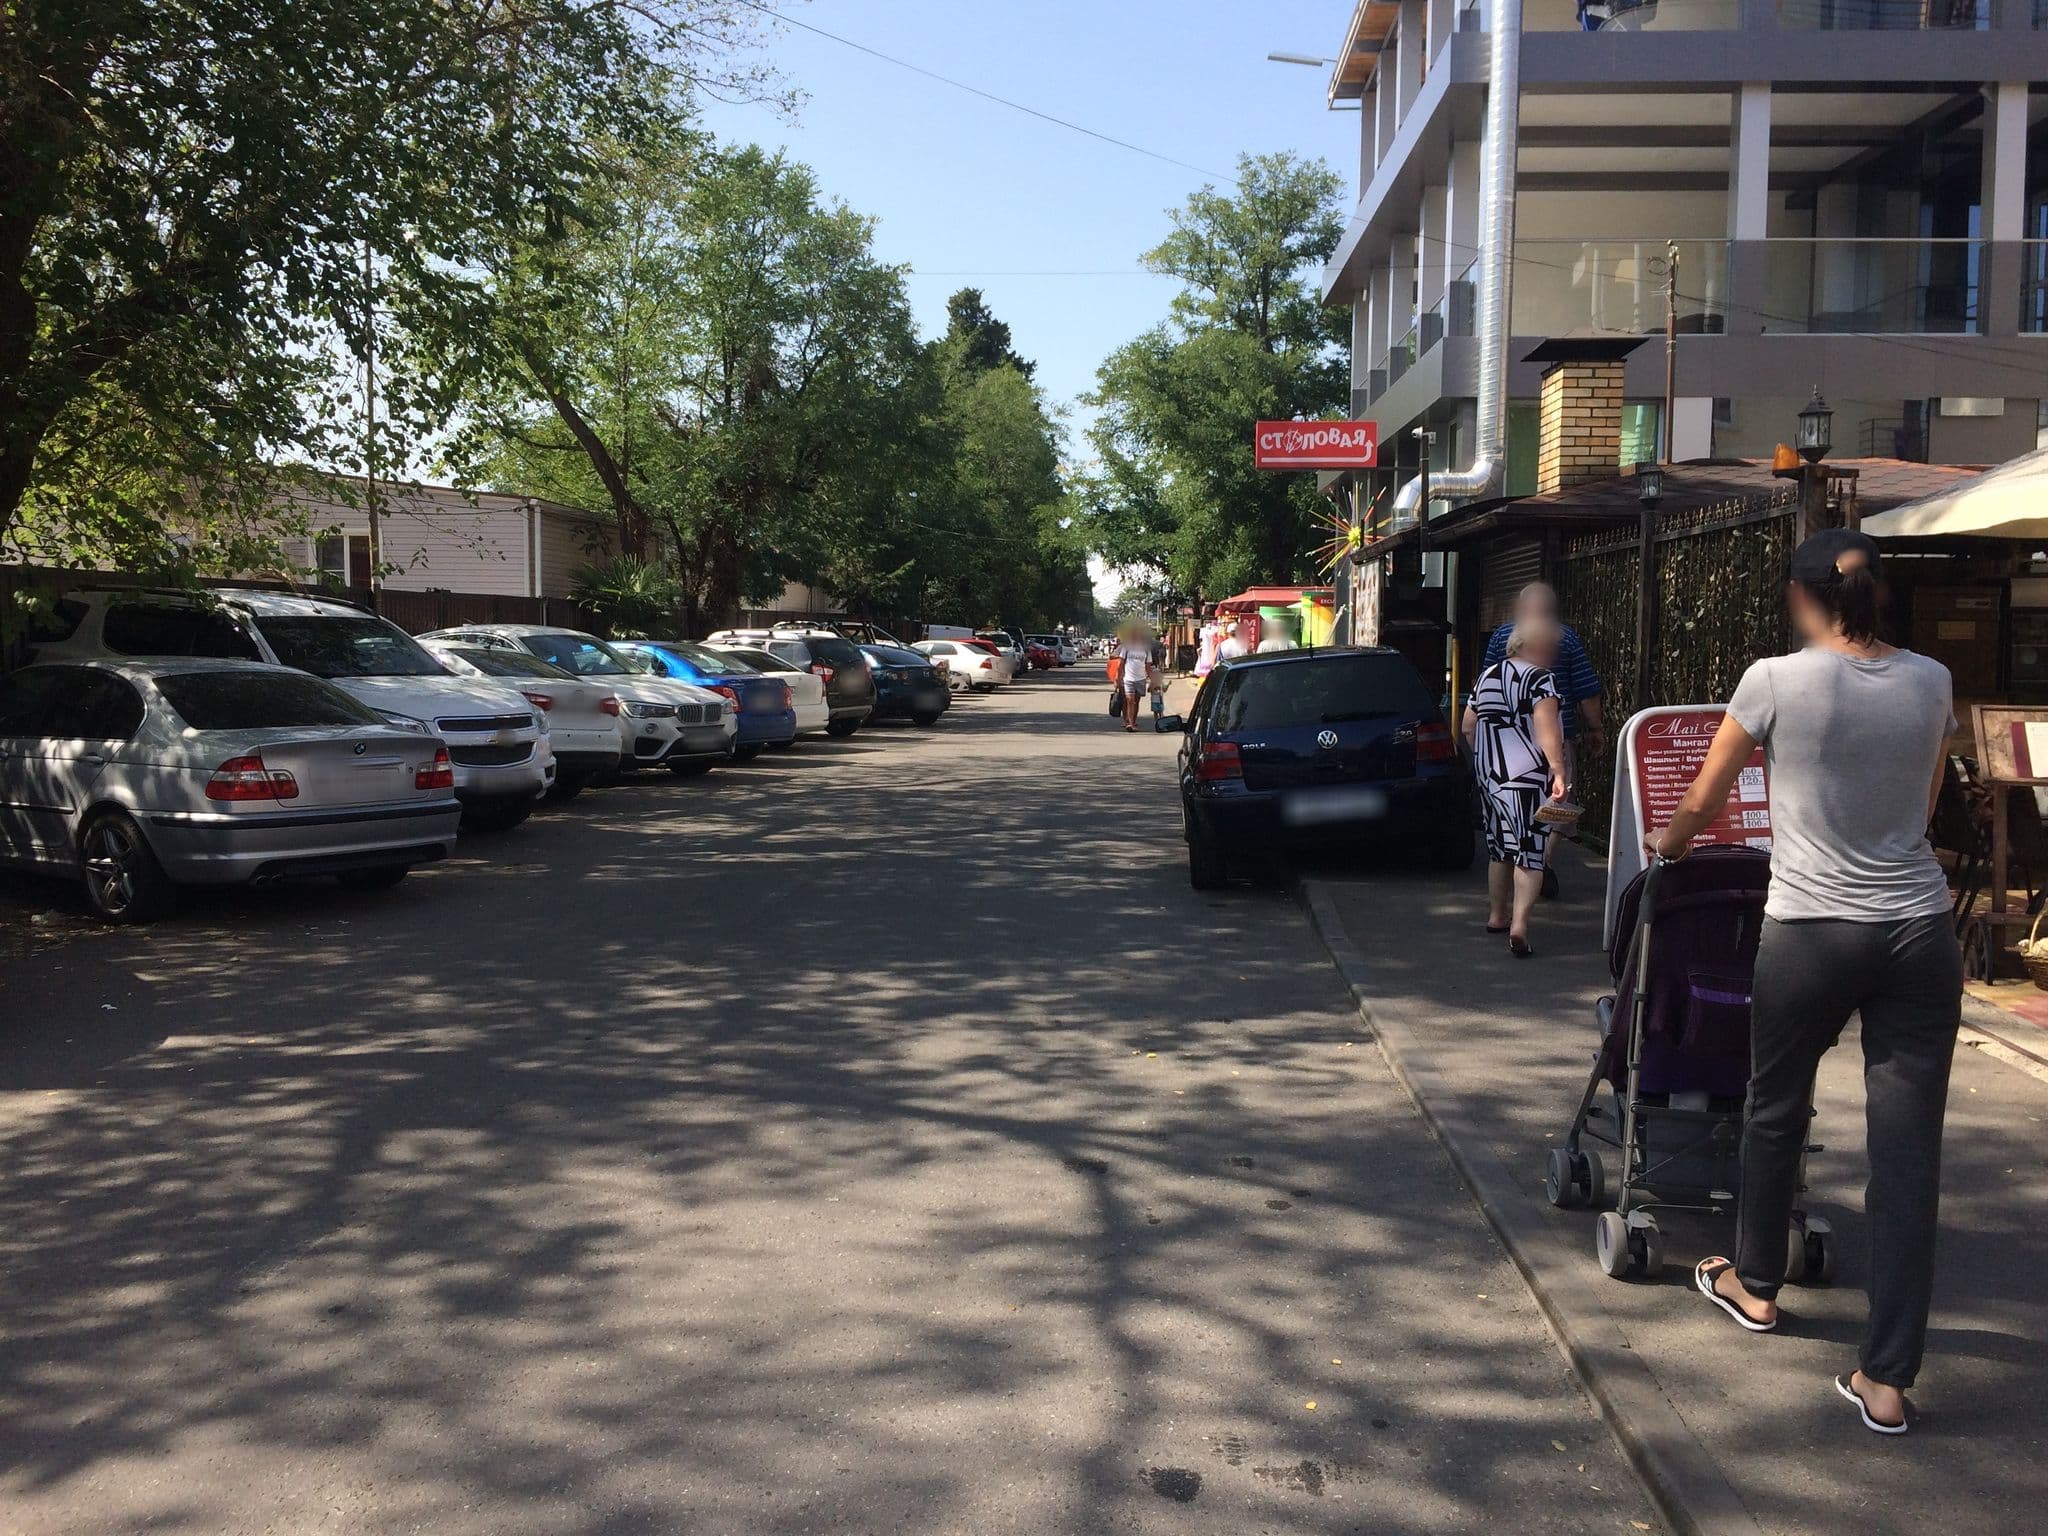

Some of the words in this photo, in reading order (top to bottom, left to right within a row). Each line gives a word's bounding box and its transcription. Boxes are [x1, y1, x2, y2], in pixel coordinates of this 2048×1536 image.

[1648, 718, 1699, 736] Mari
[1242, 742, 1266, 750] GOLF
[1672, 738, 1709, 748] Мангал
[1643, 756, 1681, 764] Шашлык
[1686, 755, 1705, 763] Barb
